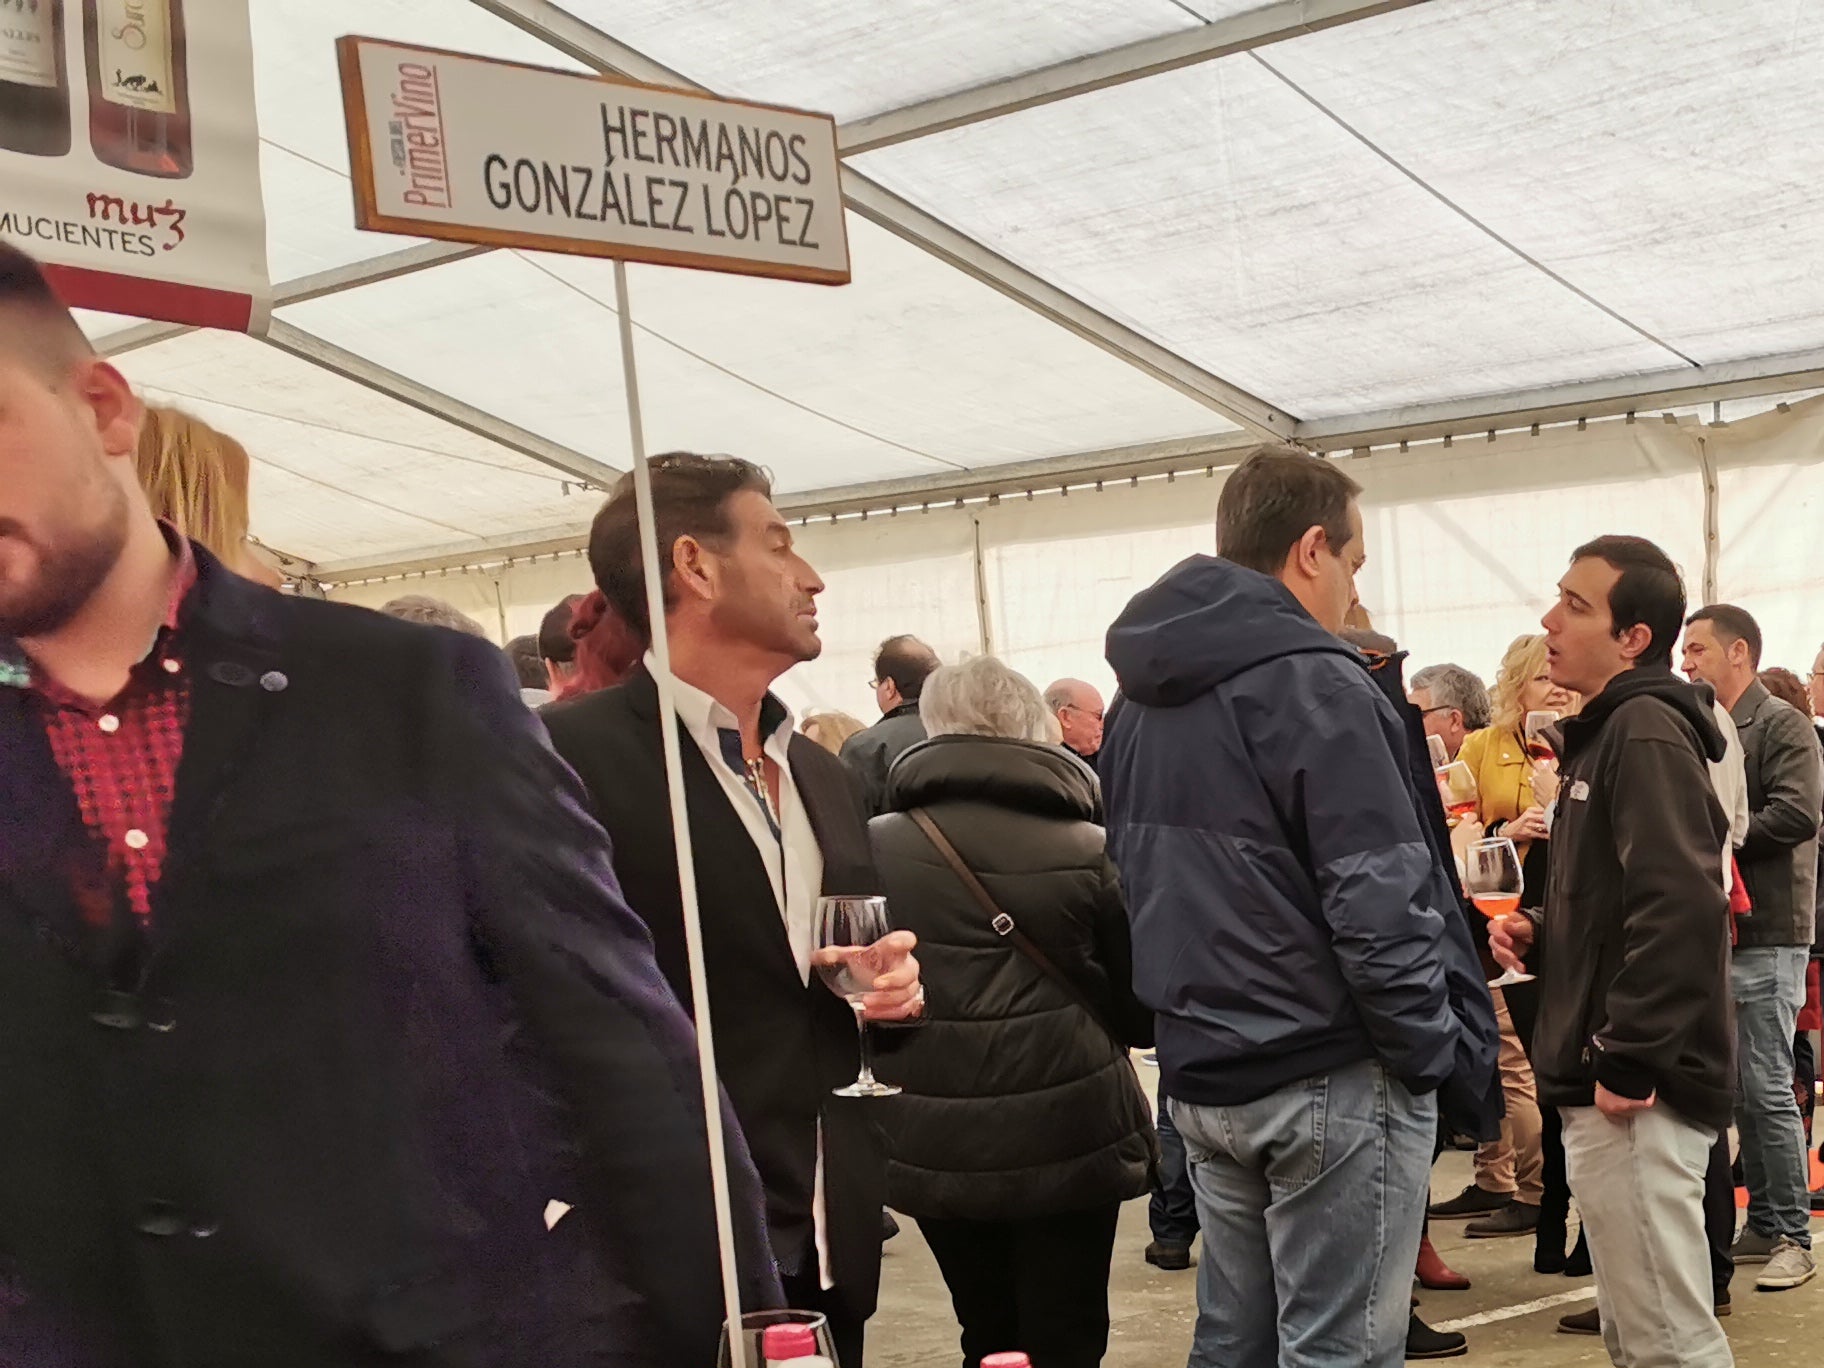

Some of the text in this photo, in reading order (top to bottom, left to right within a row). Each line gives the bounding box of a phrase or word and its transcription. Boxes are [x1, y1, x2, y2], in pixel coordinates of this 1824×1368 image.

[600, 102, 811, 186] HERMANOS
[484, 152, 819, 250] GONZÁLEZ LÓPEZ
